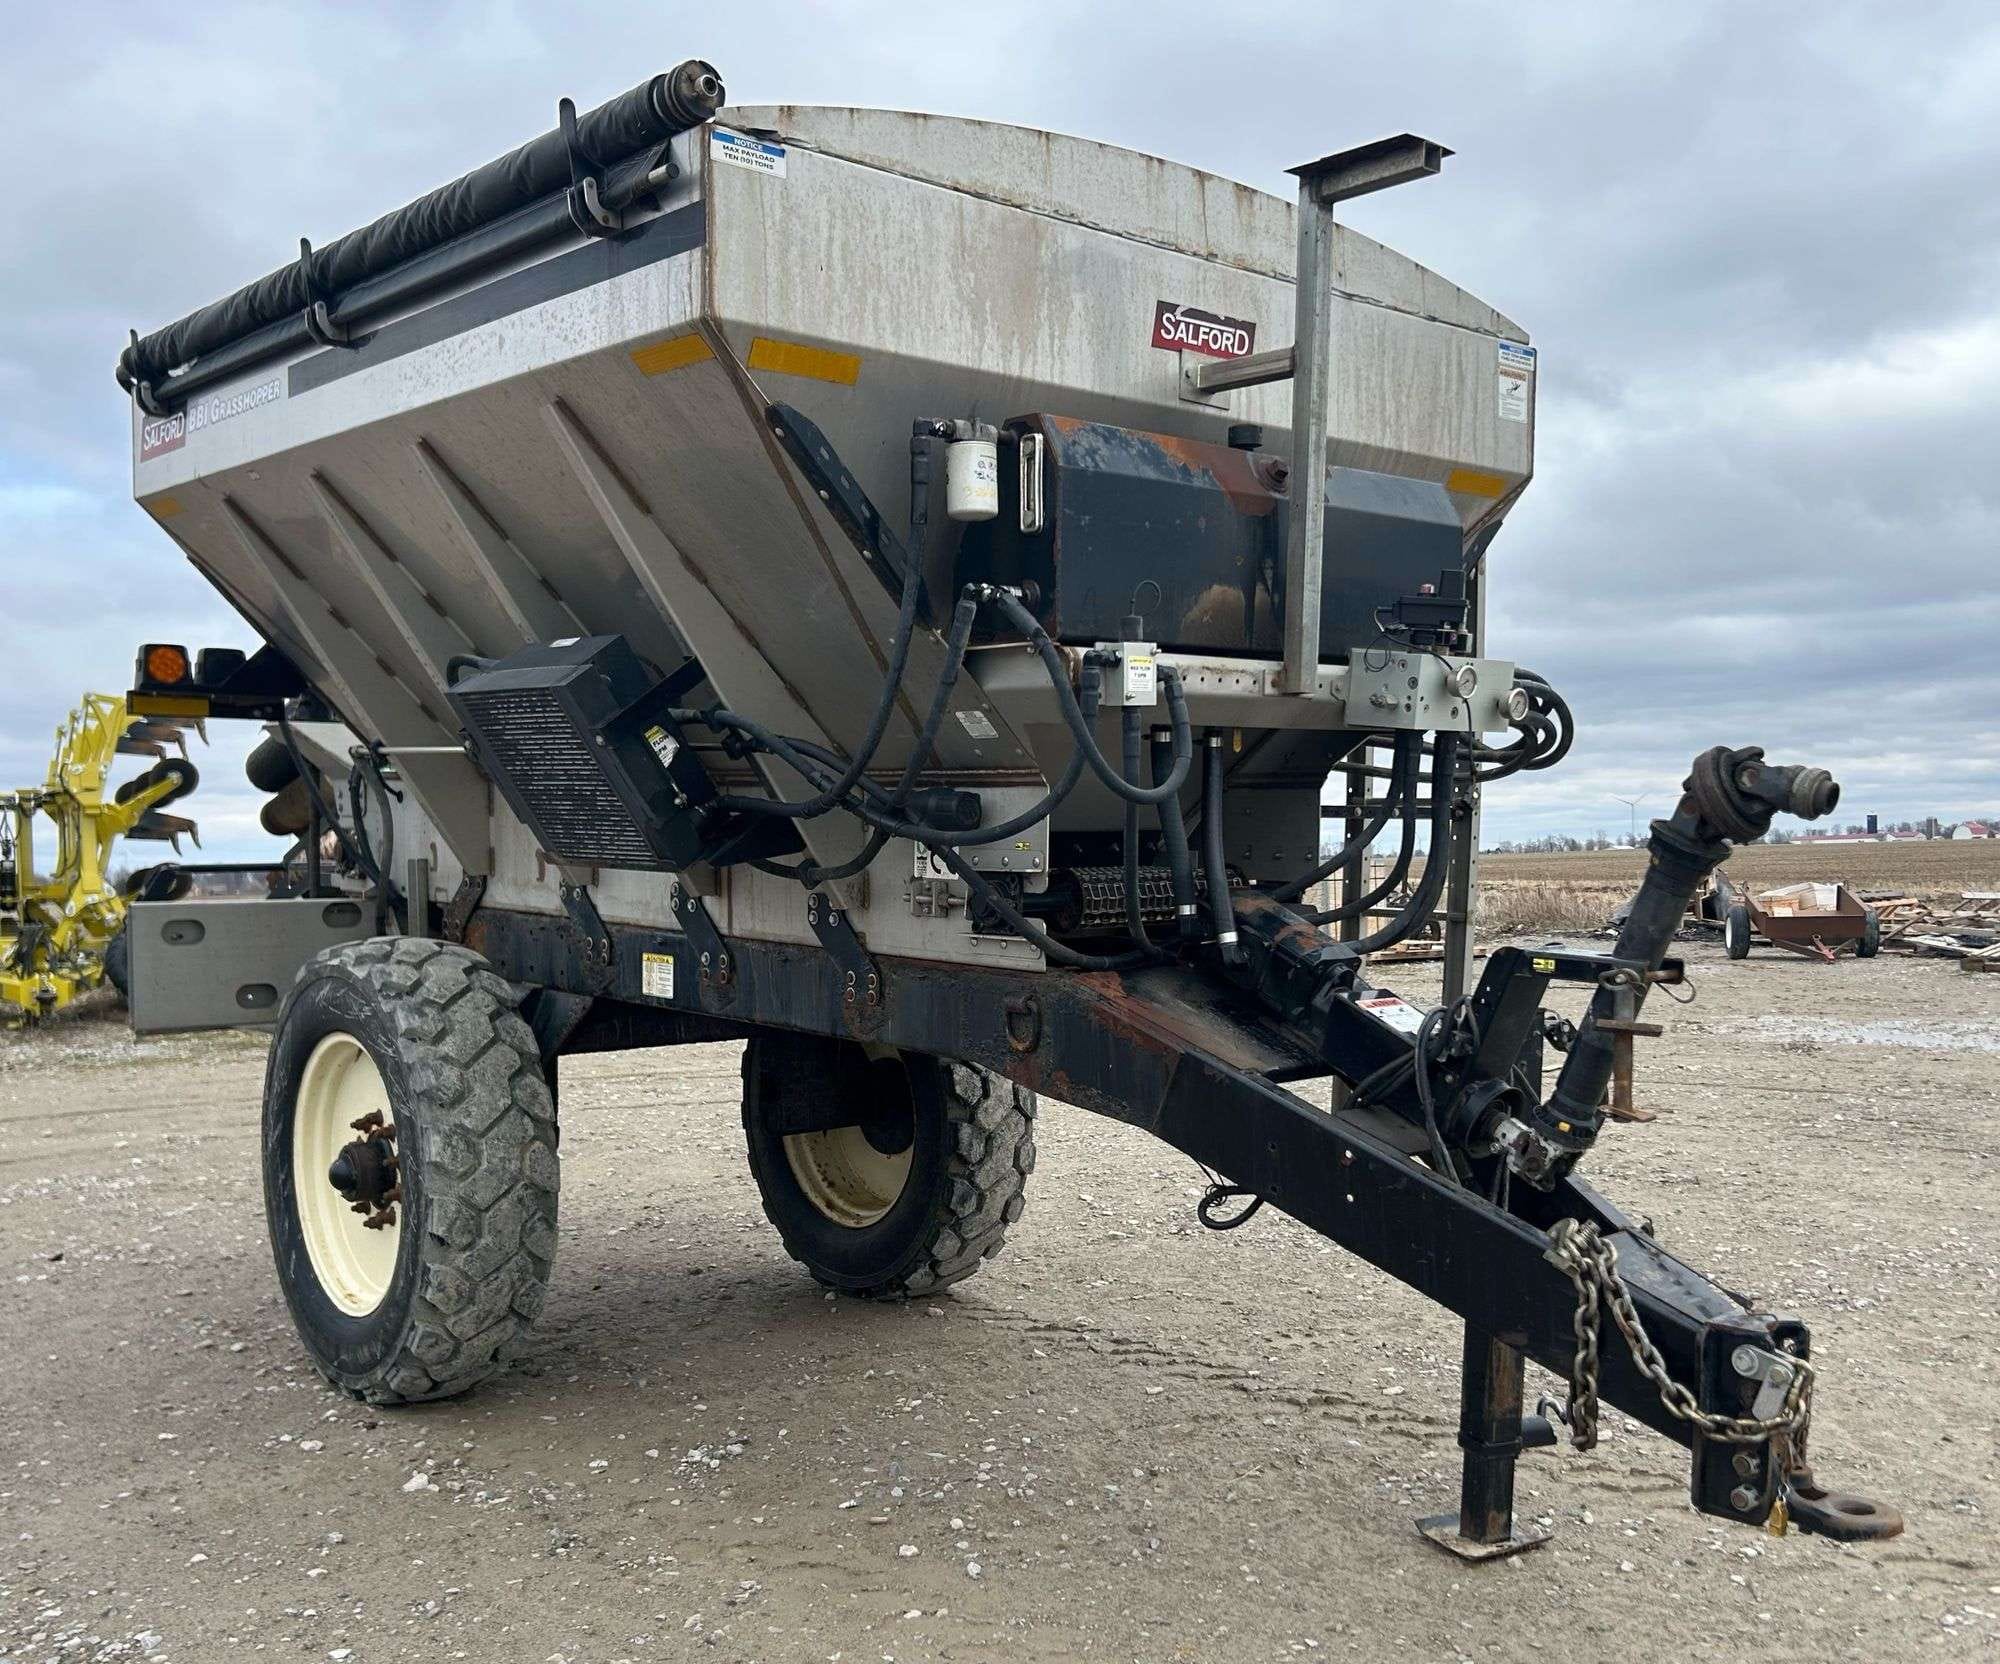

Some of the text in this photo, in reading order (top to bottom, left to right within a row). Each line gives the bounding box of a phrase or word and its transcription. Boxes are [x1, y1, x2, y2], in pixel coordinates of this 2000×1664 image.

[722, 144, 775, 163] MAX PAYLOAD
[734, 138, 763, 152] NOTICE
[724, 152, 739, 162] TEN
[754, 160, 774, 170] TONS
[1160, 312, 1249, 355] SALFORD
[143, 411, 185, 451] SALFORD
[188, 401, 209, 433] BBI
